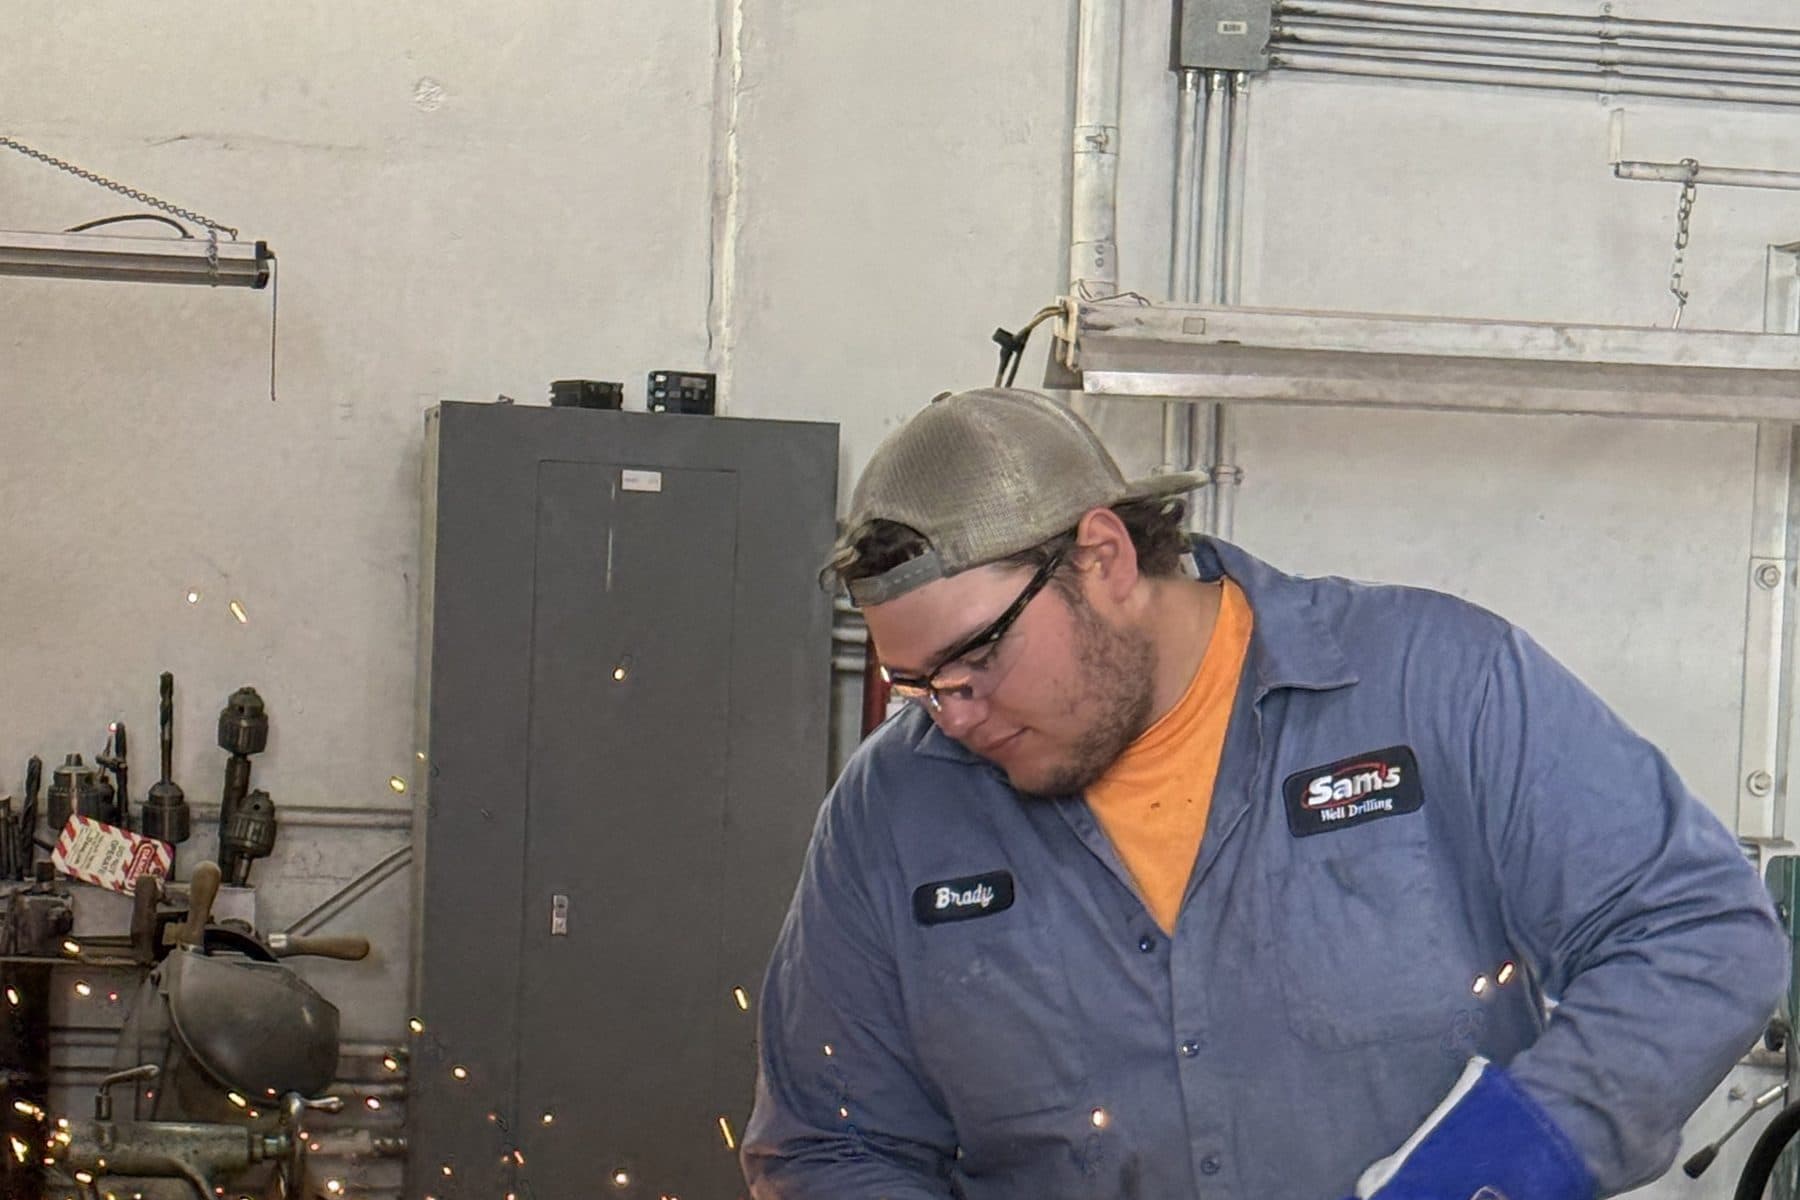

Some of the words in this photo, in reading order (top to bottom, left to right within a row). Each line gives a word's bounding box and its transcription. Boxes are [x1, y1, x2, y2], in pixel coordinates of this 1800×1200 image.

[1308, 763, 1401, 806] Sam's
[1320, 807, 1346, 821] Well
[1348, 798, 1393, 817] Drilling
[935, 883, 994, 909] Brady
